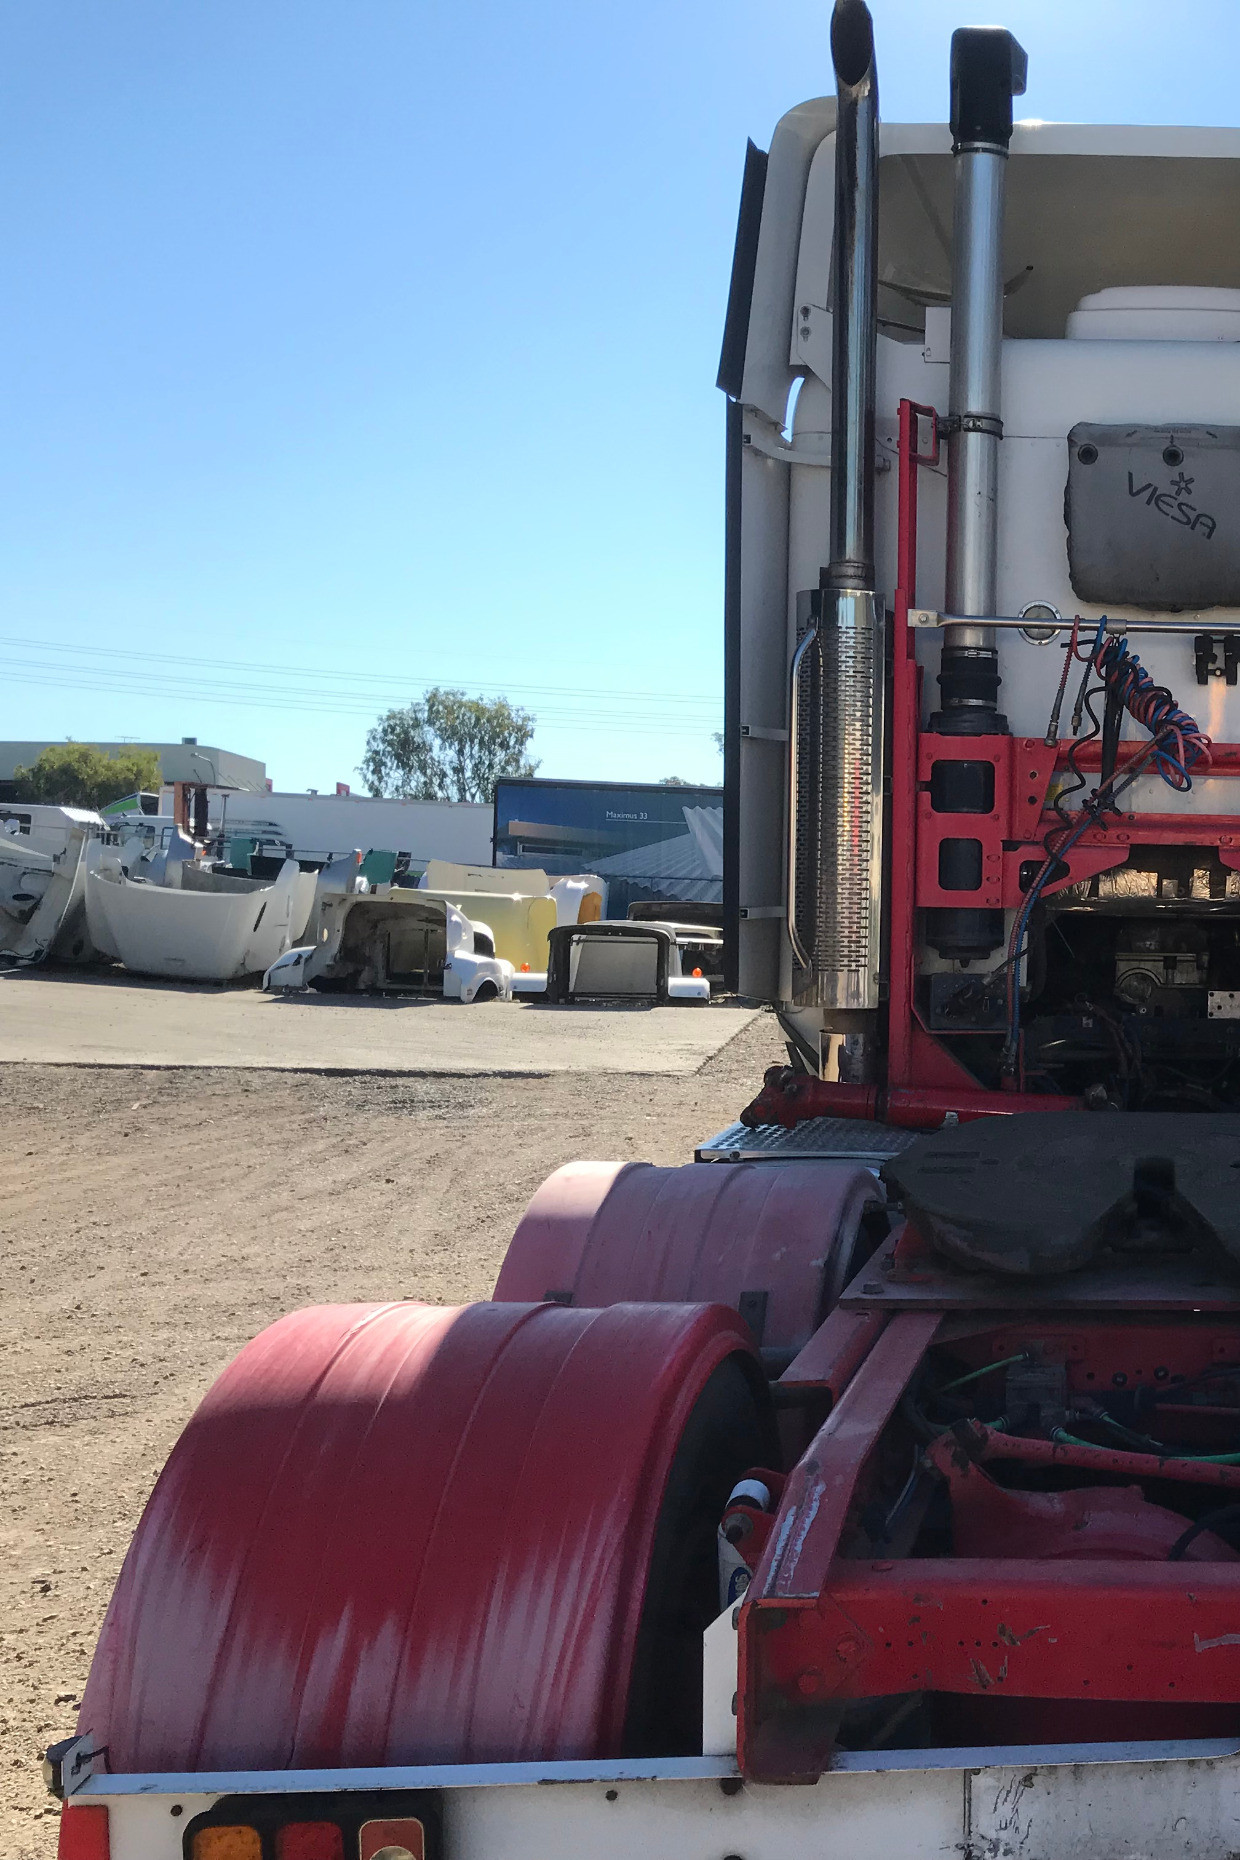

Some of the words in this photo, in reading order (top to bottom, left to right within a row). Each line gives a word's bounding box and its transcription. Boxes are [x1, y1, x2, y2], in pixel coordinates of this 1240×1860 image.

[1127, 470, 1217, 540] VIESA
[606, 810, 638, 820] Maximus
[639, 812, 648, 820] 33
